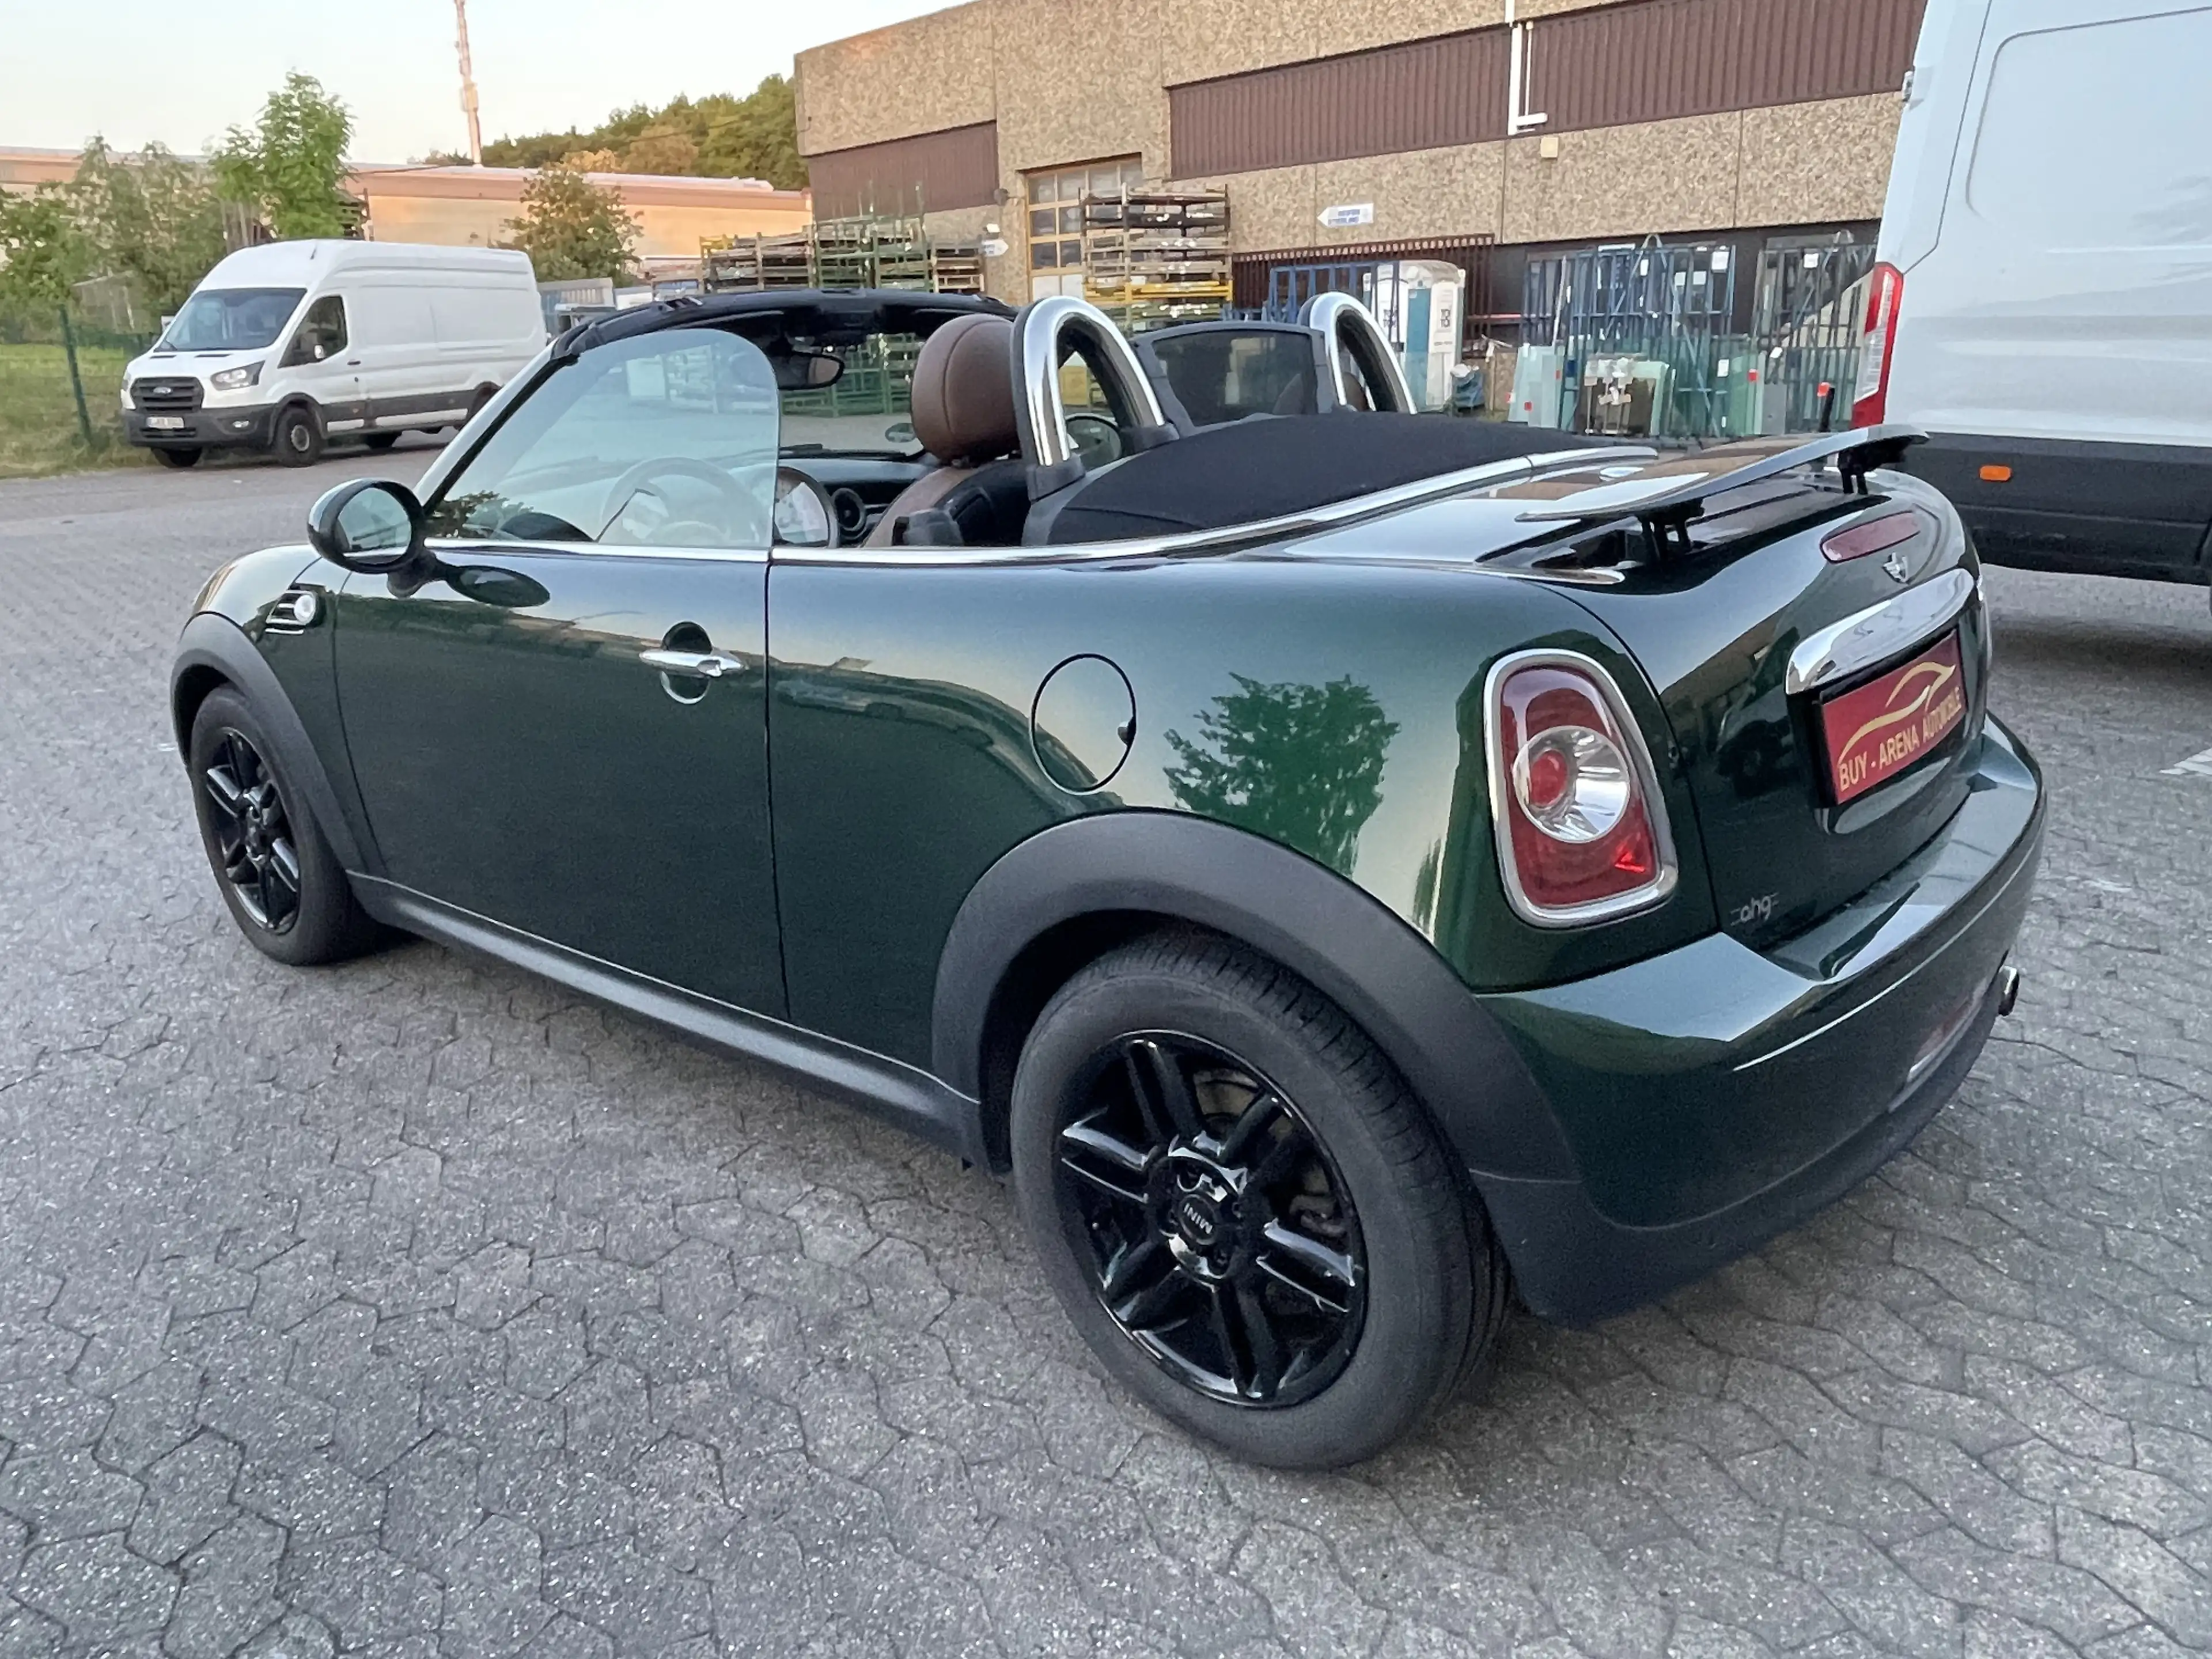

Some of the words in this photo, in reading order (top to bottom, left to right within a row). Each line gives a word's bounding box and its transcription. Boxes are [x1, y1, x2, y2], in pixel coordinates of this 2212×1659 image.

[1839, 751, 1867, 791] BUY
[1880, 725, 1920, 770] ARENA
[1184, 1203, 1213, 1234] MINI
